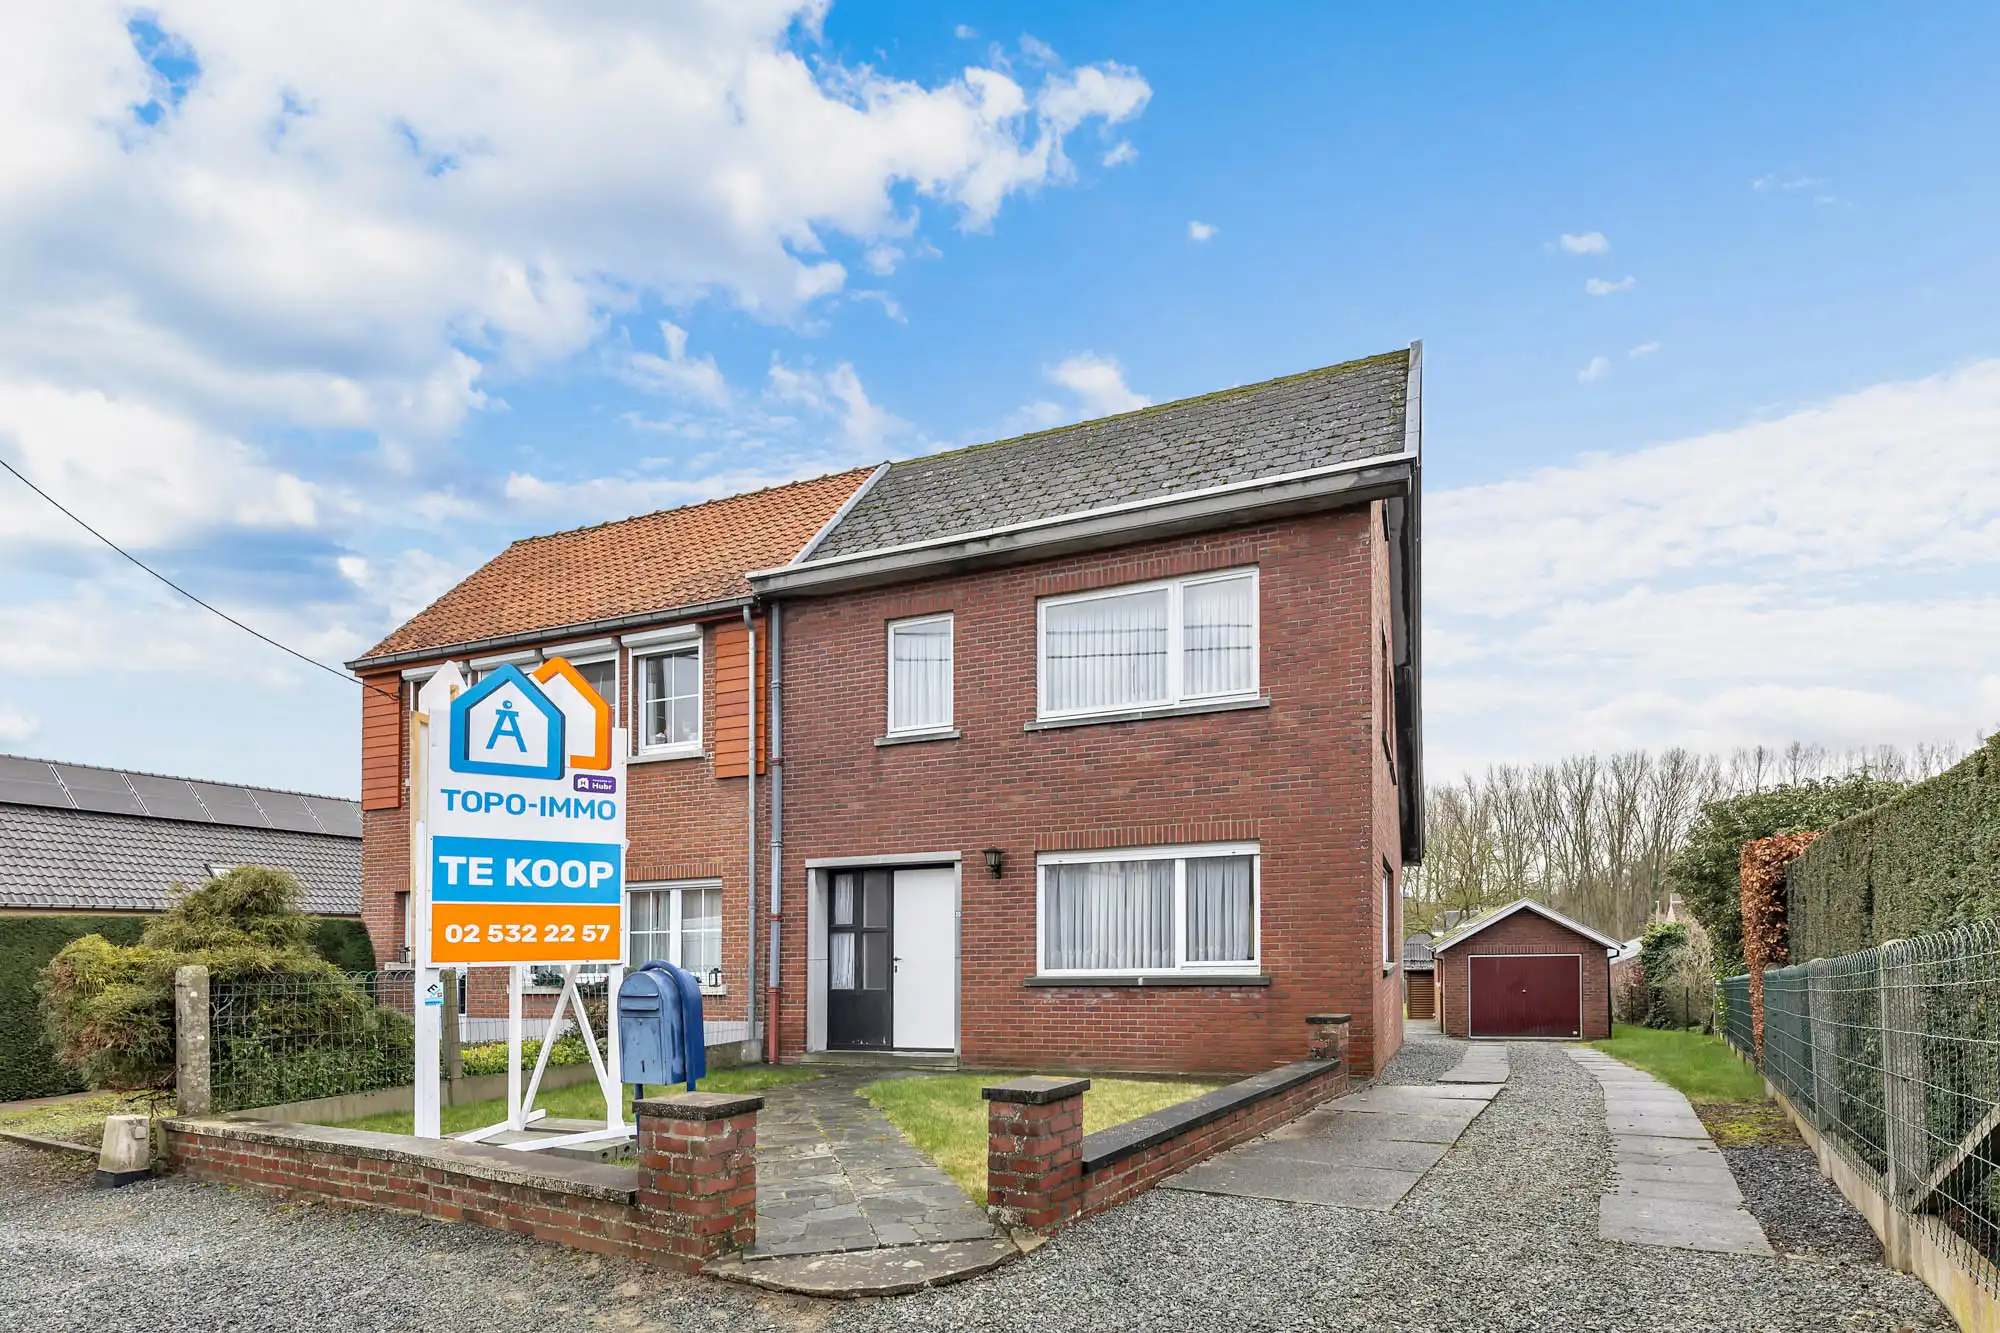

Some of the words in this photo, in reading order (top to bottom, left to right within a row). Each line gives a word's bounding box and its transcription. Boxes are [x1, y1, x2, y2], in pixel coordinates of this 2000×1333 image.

[441, 789, 616, 820] TOPO-IMMO
[439, 856, 493, 886] TE
[507, 859, 614, 889] KOOP
[446, 923, 480, 943] 02
[488, 924, 538, 943] 532
[544, 924, 576, 943] 22
[582, 924, 611, 943] 57
